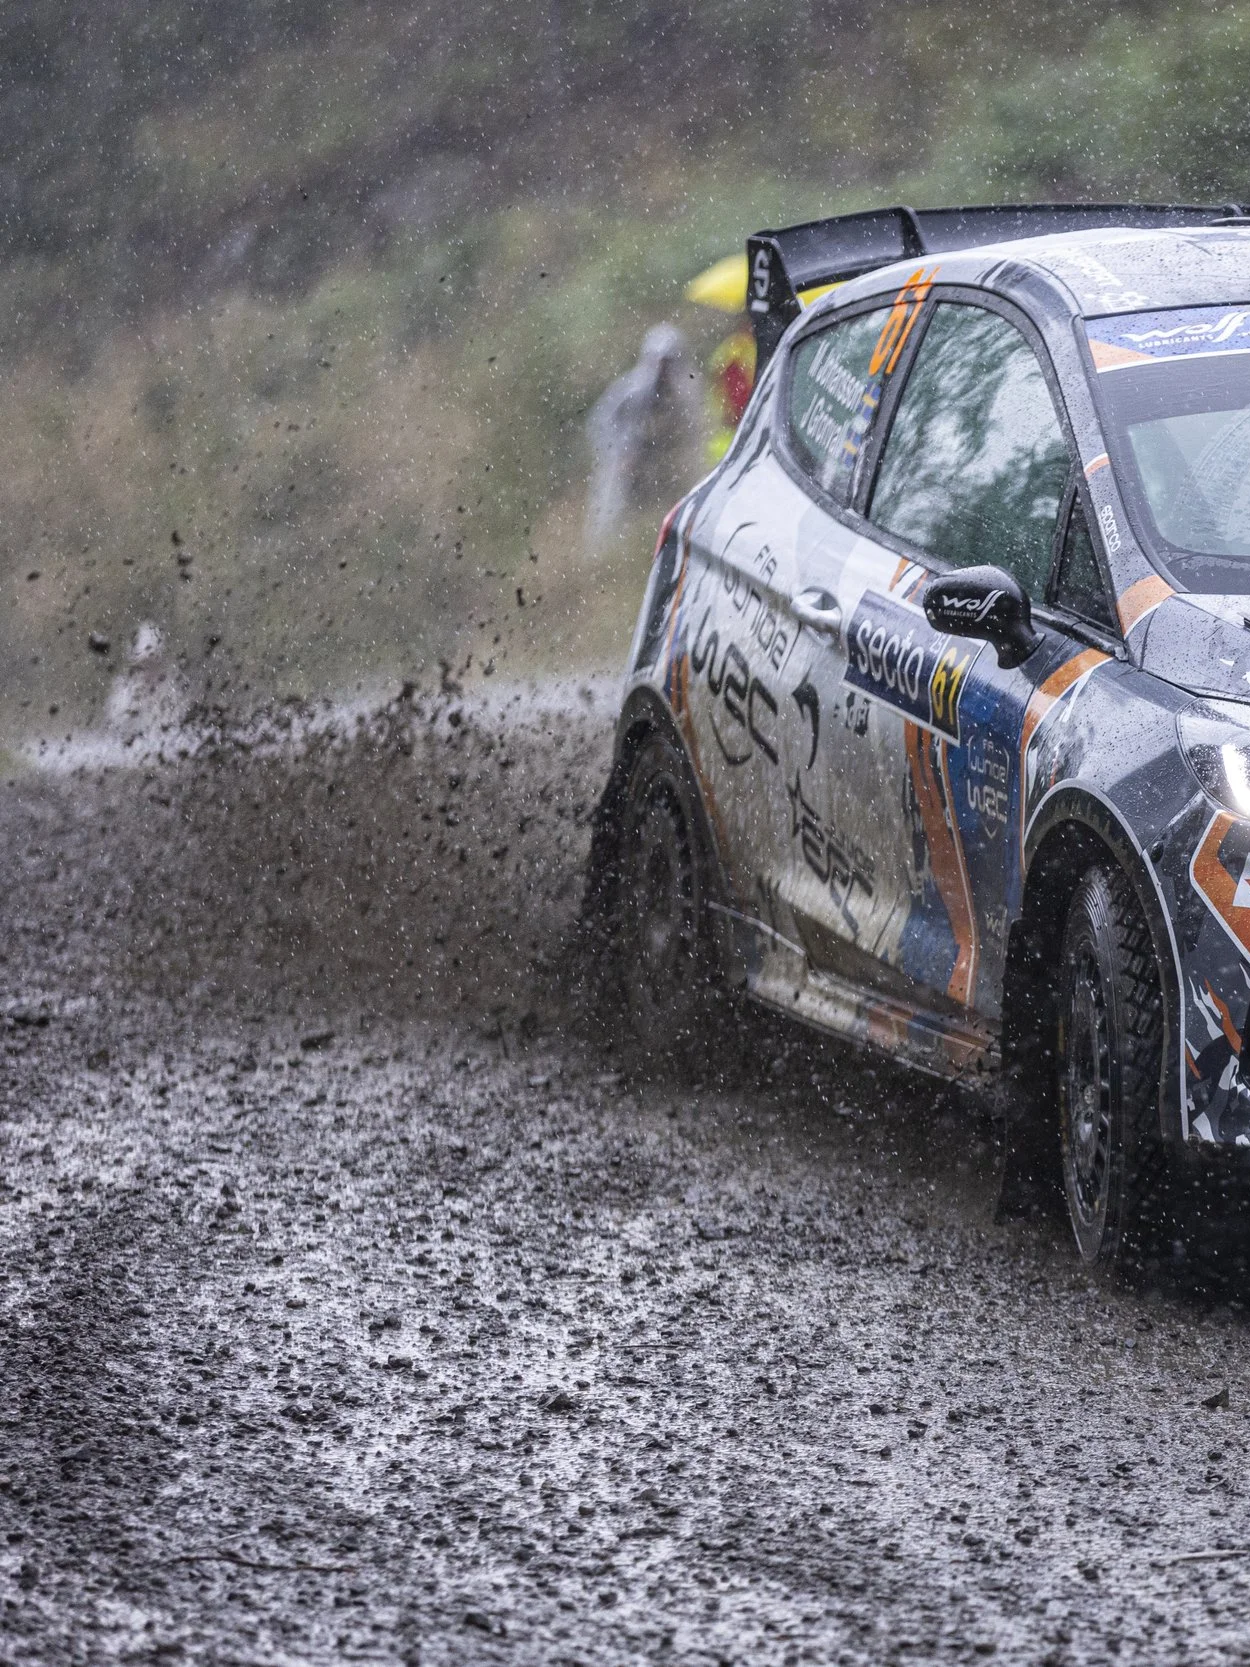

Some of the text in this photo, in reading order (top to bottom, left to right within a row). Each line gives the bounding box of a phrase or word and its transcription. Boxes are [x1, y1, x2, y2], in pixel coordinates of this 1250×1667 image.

[868, 264, 941, 376] 61
[856, 619, 924, 701] secto
[932, 647, 970, 726] 61
